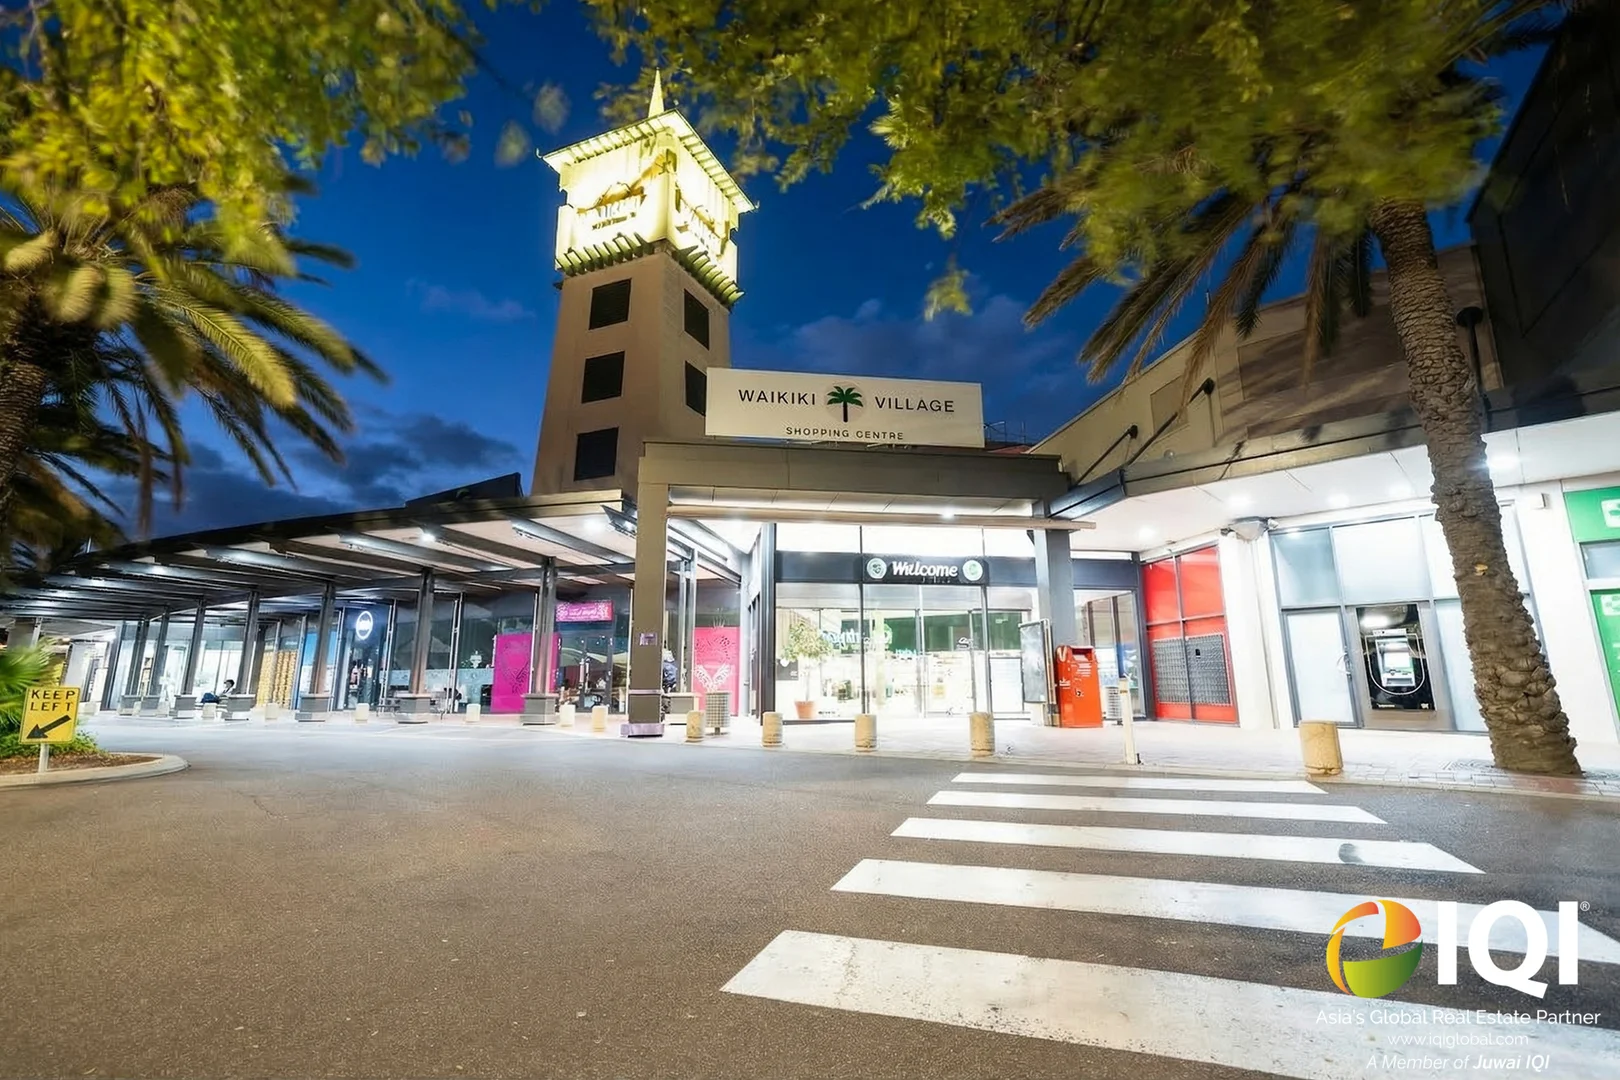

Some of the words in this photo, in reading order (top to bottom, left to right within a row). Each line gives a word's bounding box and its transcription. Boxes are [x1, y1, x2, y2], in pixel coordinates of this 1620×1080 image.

[738, 389, 817, 406] WAIKIKI
[874, 396, 955, 413] VILLAGE
[785, 426, 850, 438] SHOPPING
[855, 430, 904, 441] CENTRE
[31, 690, 76, 700] KEEP
[30, 702, 74, 712] LEFT
